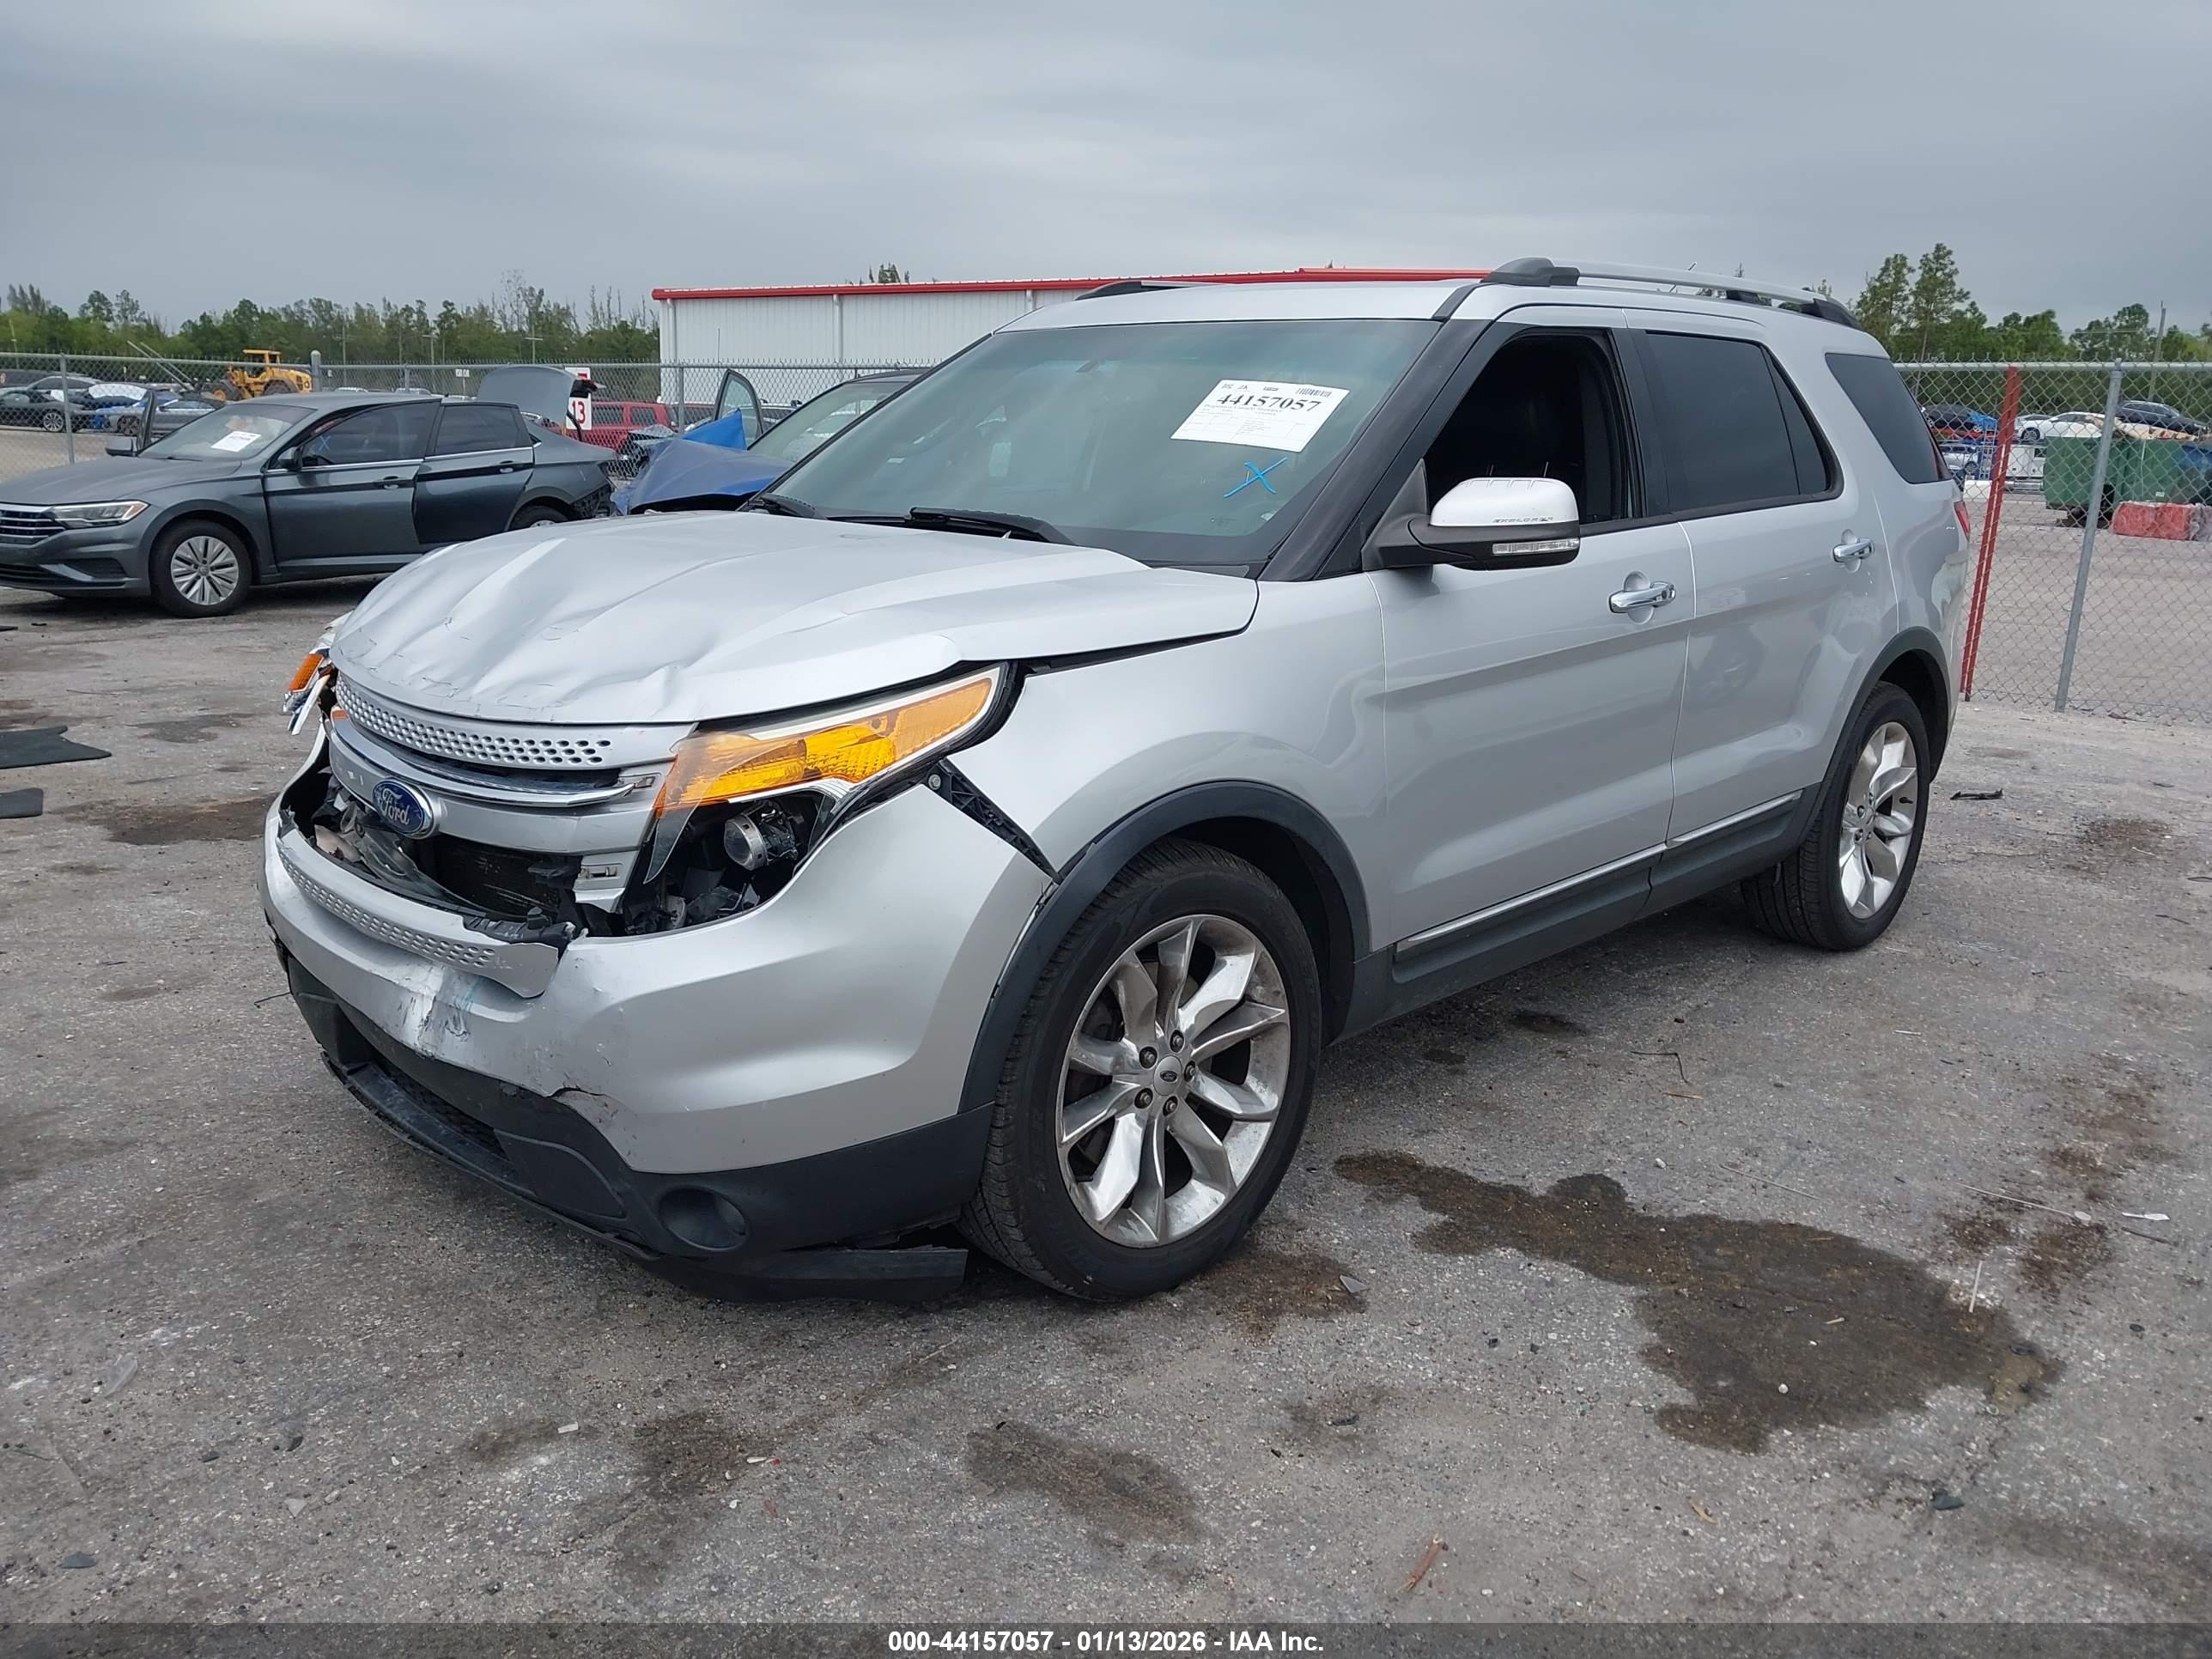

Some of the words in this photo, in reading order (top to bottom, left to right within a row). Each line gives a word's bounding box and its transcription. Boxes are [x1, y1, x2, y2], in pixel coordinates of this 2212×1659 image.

[572, 400, 586, 423] 13
[1217, 393, 1322, 412] 44157057
[380, 787, 410, 824] Ford
